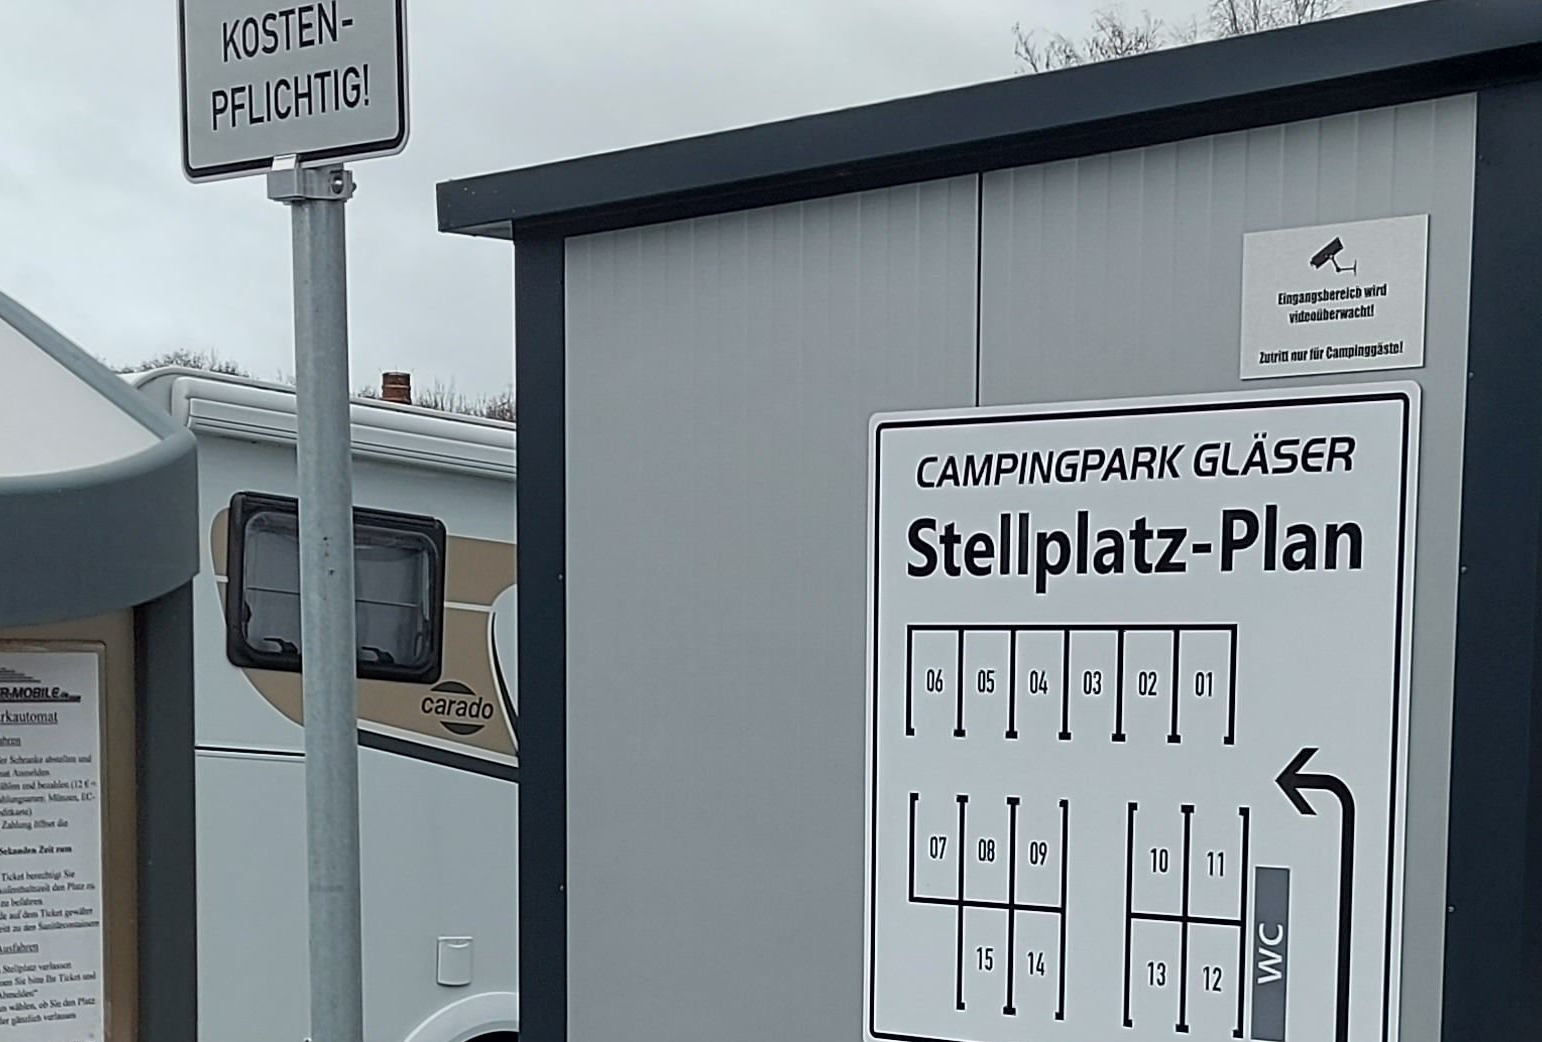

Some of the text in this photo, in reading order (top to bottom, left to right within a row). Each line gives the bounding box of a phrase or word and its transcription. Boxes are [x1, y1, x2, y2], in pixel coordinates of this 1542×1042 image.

[222, 0, 353, 62] KOSTEN-
[212, 64, 369, 130] PFLICHTIG!
[1278, 283, 1387, 306] Eingangsbereich wird
[1289, 304, 1374, 323] videoüberwacht!
[1259, 341, 1403, 364] Zutritt nur für Campinggäste!
[917, 433, 1357, 489] CAMPINGPARK GLÄSER
[907, 503, 1362, 594] Stellplatz-Plan
[926, 669, 943, 694] 06
[977, 670, 995, 694] 05
[1029, 670, 1048, 696] 04
[1083, 671, 1102, 696] 03
[1139, 672, 1157, 697] 02
[1195, 672, 1213, 698] 01
[421, 697, 494, 719] carado
[929, 836, 947, 861] 07
[978, 838, 995, 863] 08
[1029, 841, 1047, 866] 09
[1151, 848, 1168, 874] 10
[1207, 852, 1224, 877] 11
[976, 948, 994, 972] 15
[1027, 951, 1046, 976] 14
[1258, 923, 1283, 984] WC
[1147, 962, 1166, 987] 13
[1203, 966, 1222, 992] 12
